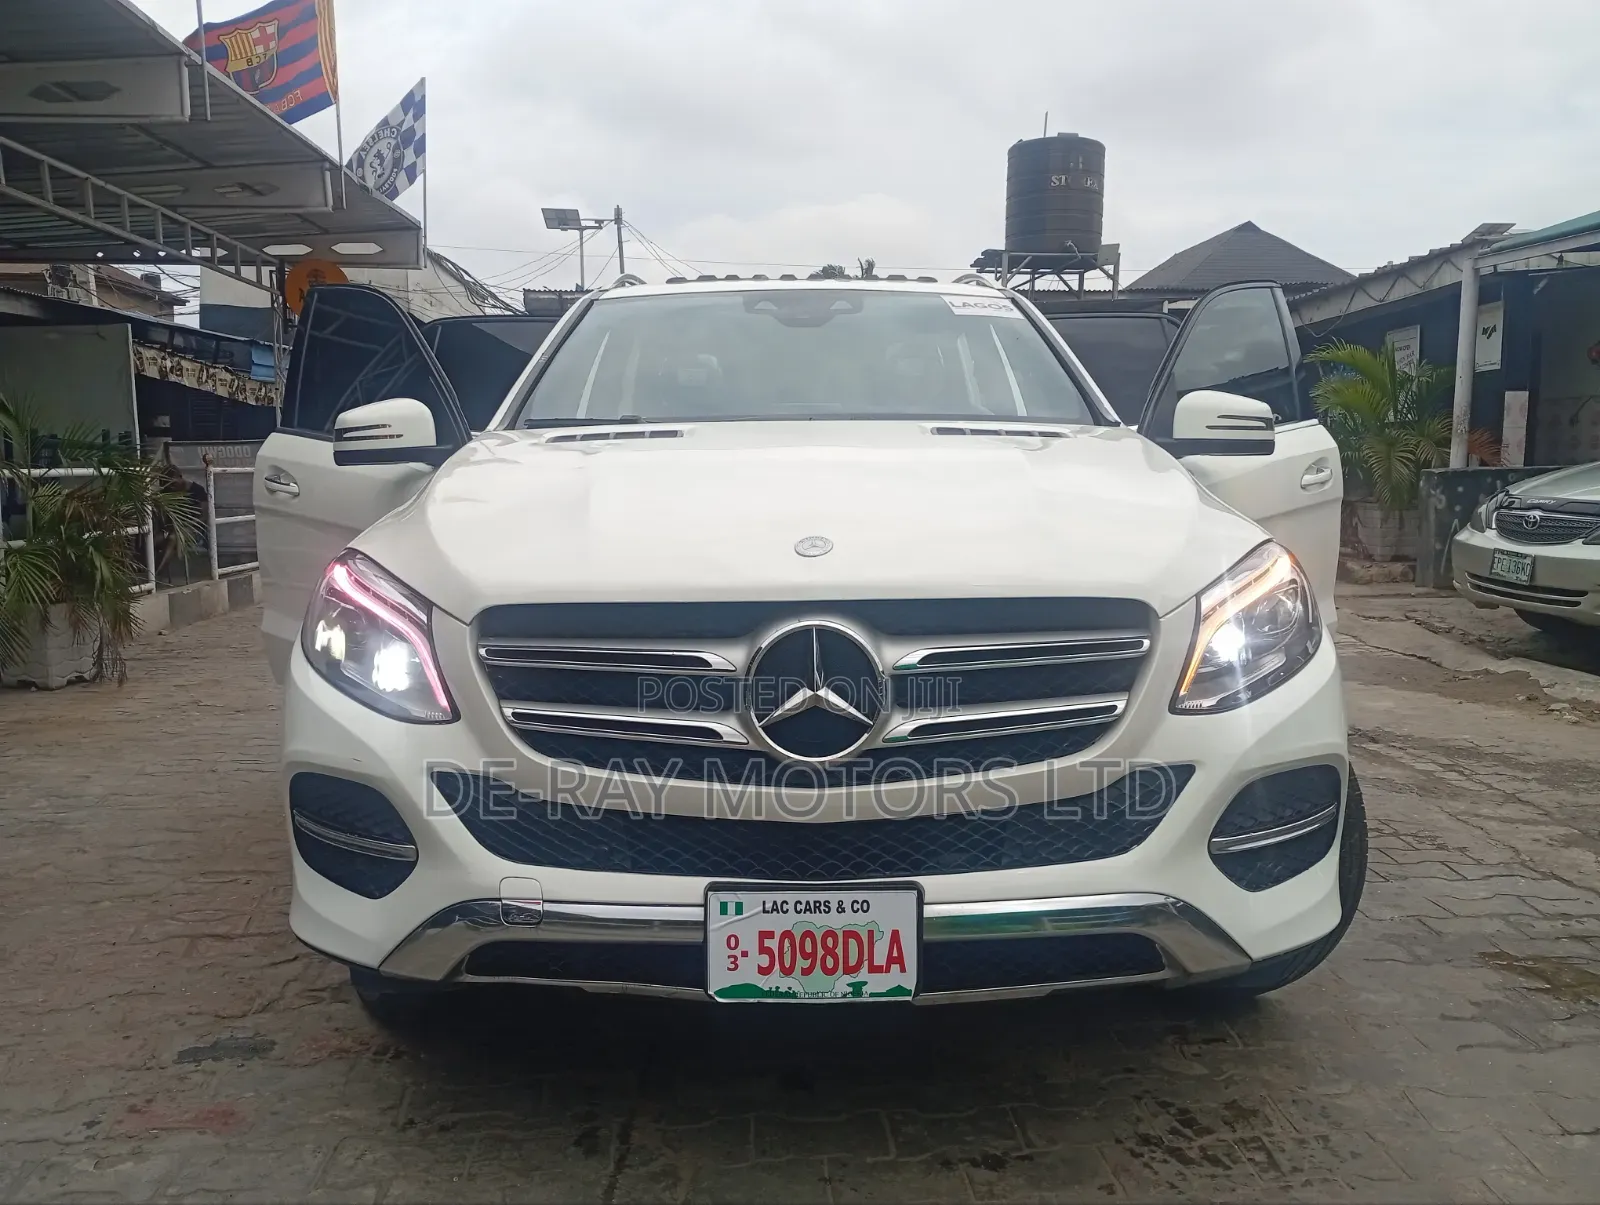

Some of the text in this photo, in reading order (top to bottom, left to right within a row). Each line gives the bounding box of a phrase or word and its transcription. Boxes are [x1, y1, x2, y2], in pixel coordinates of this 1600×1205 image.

[948, 301, 1014, 312] LAGOS
[762, 899, 870, 914] LAC CARS & CO
